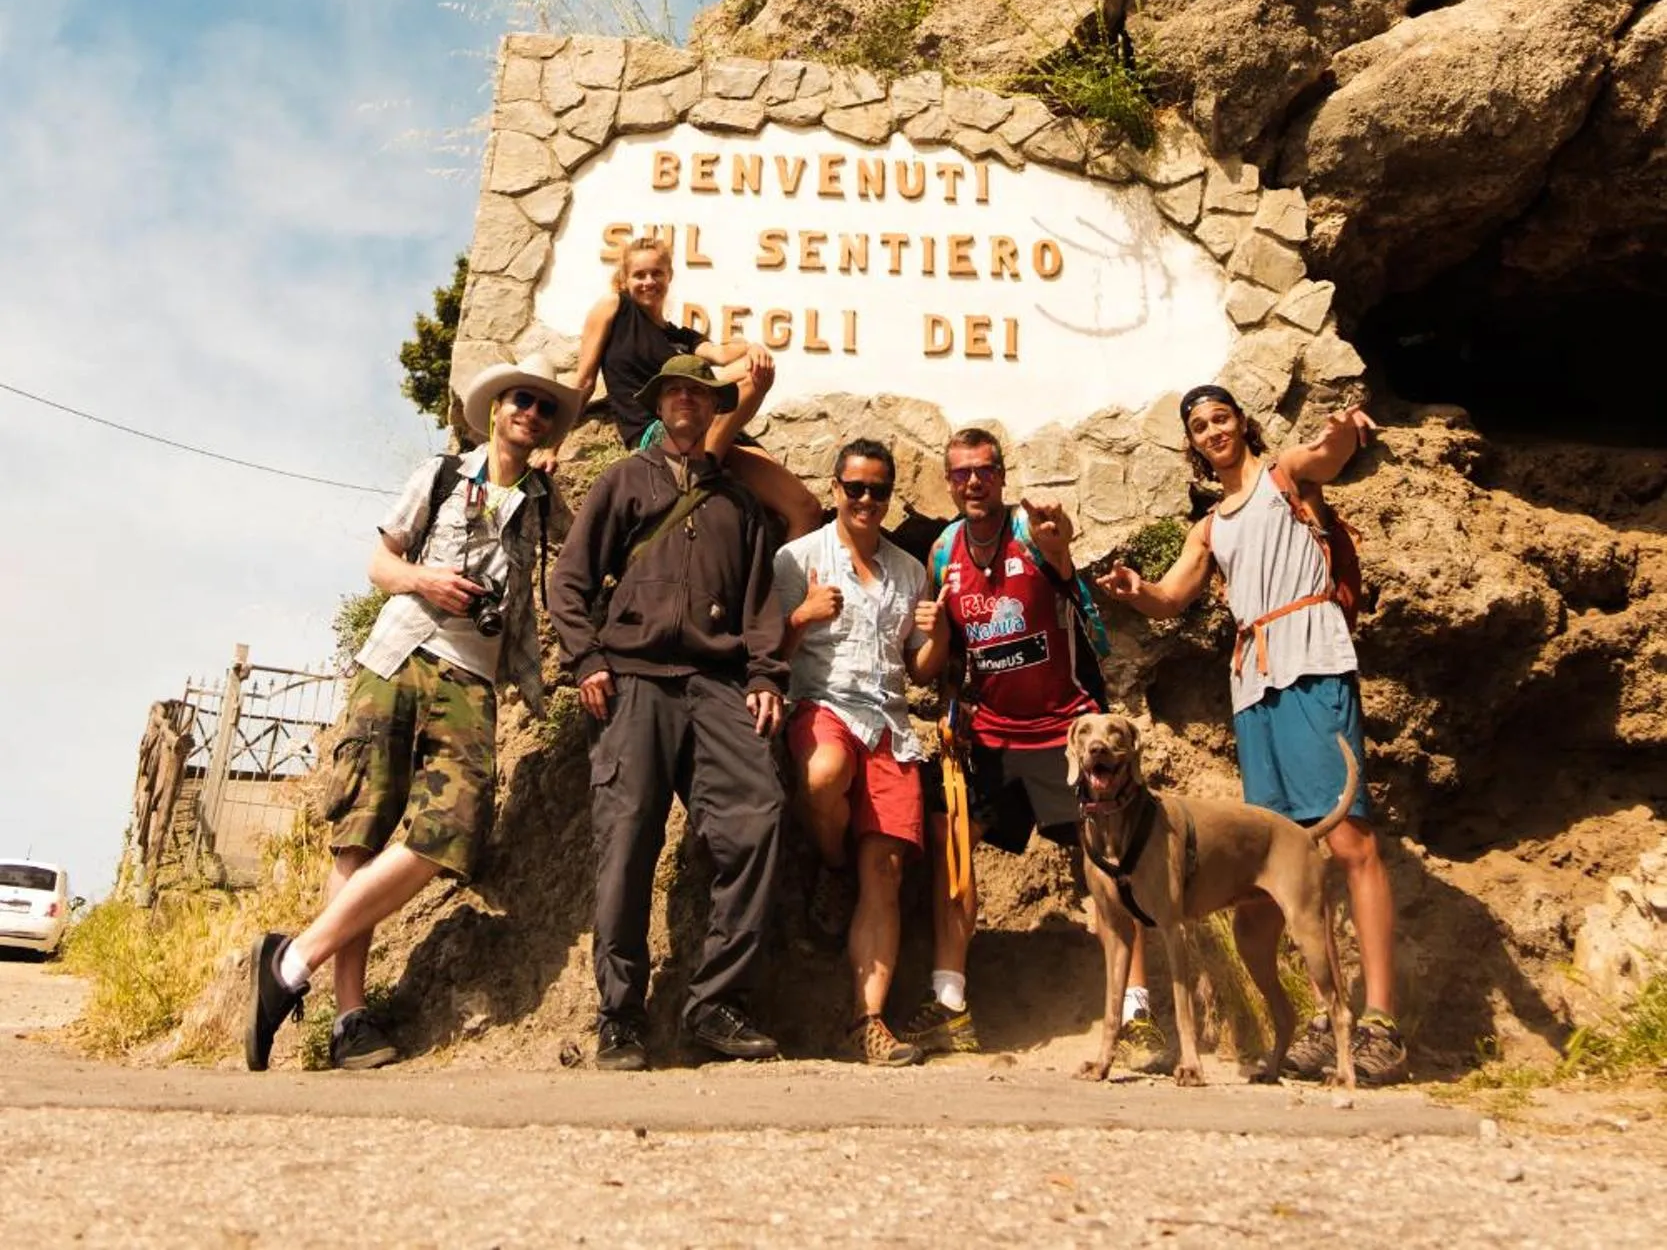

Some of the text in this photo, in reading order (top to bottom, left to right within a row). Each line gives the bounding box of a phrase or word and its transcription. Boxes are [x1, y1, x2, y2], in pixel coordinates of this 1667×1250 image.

[652, 151, 989, 204] BENVENUTI
[756, 229, 1064, 281] SENTIERO
[682, 302, 1018, 360] DEGLI DEI
